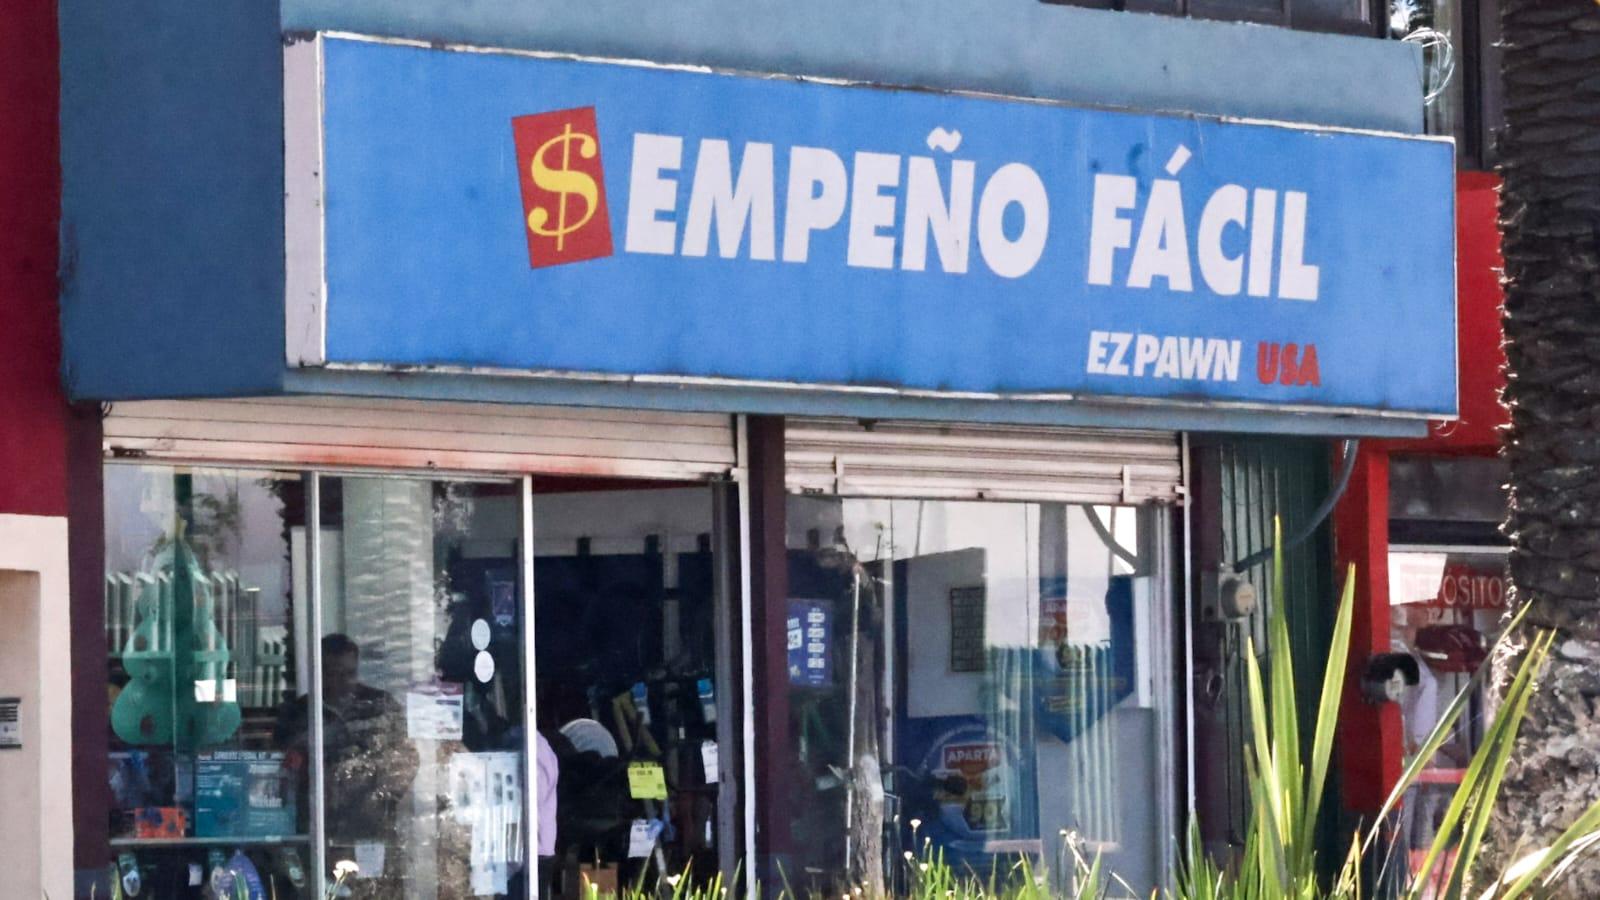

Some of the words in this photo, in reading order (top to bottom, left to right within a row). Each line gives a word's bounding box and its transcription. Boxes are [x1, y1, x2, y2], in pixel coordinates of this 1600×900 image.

[625, 127, 1050, 279] EMPEÑO
[1087, 145, 1320, 301] FÁCIL
[1257, 341, 1321, 387] USA
[947, 747, 998, 763] APARTA
